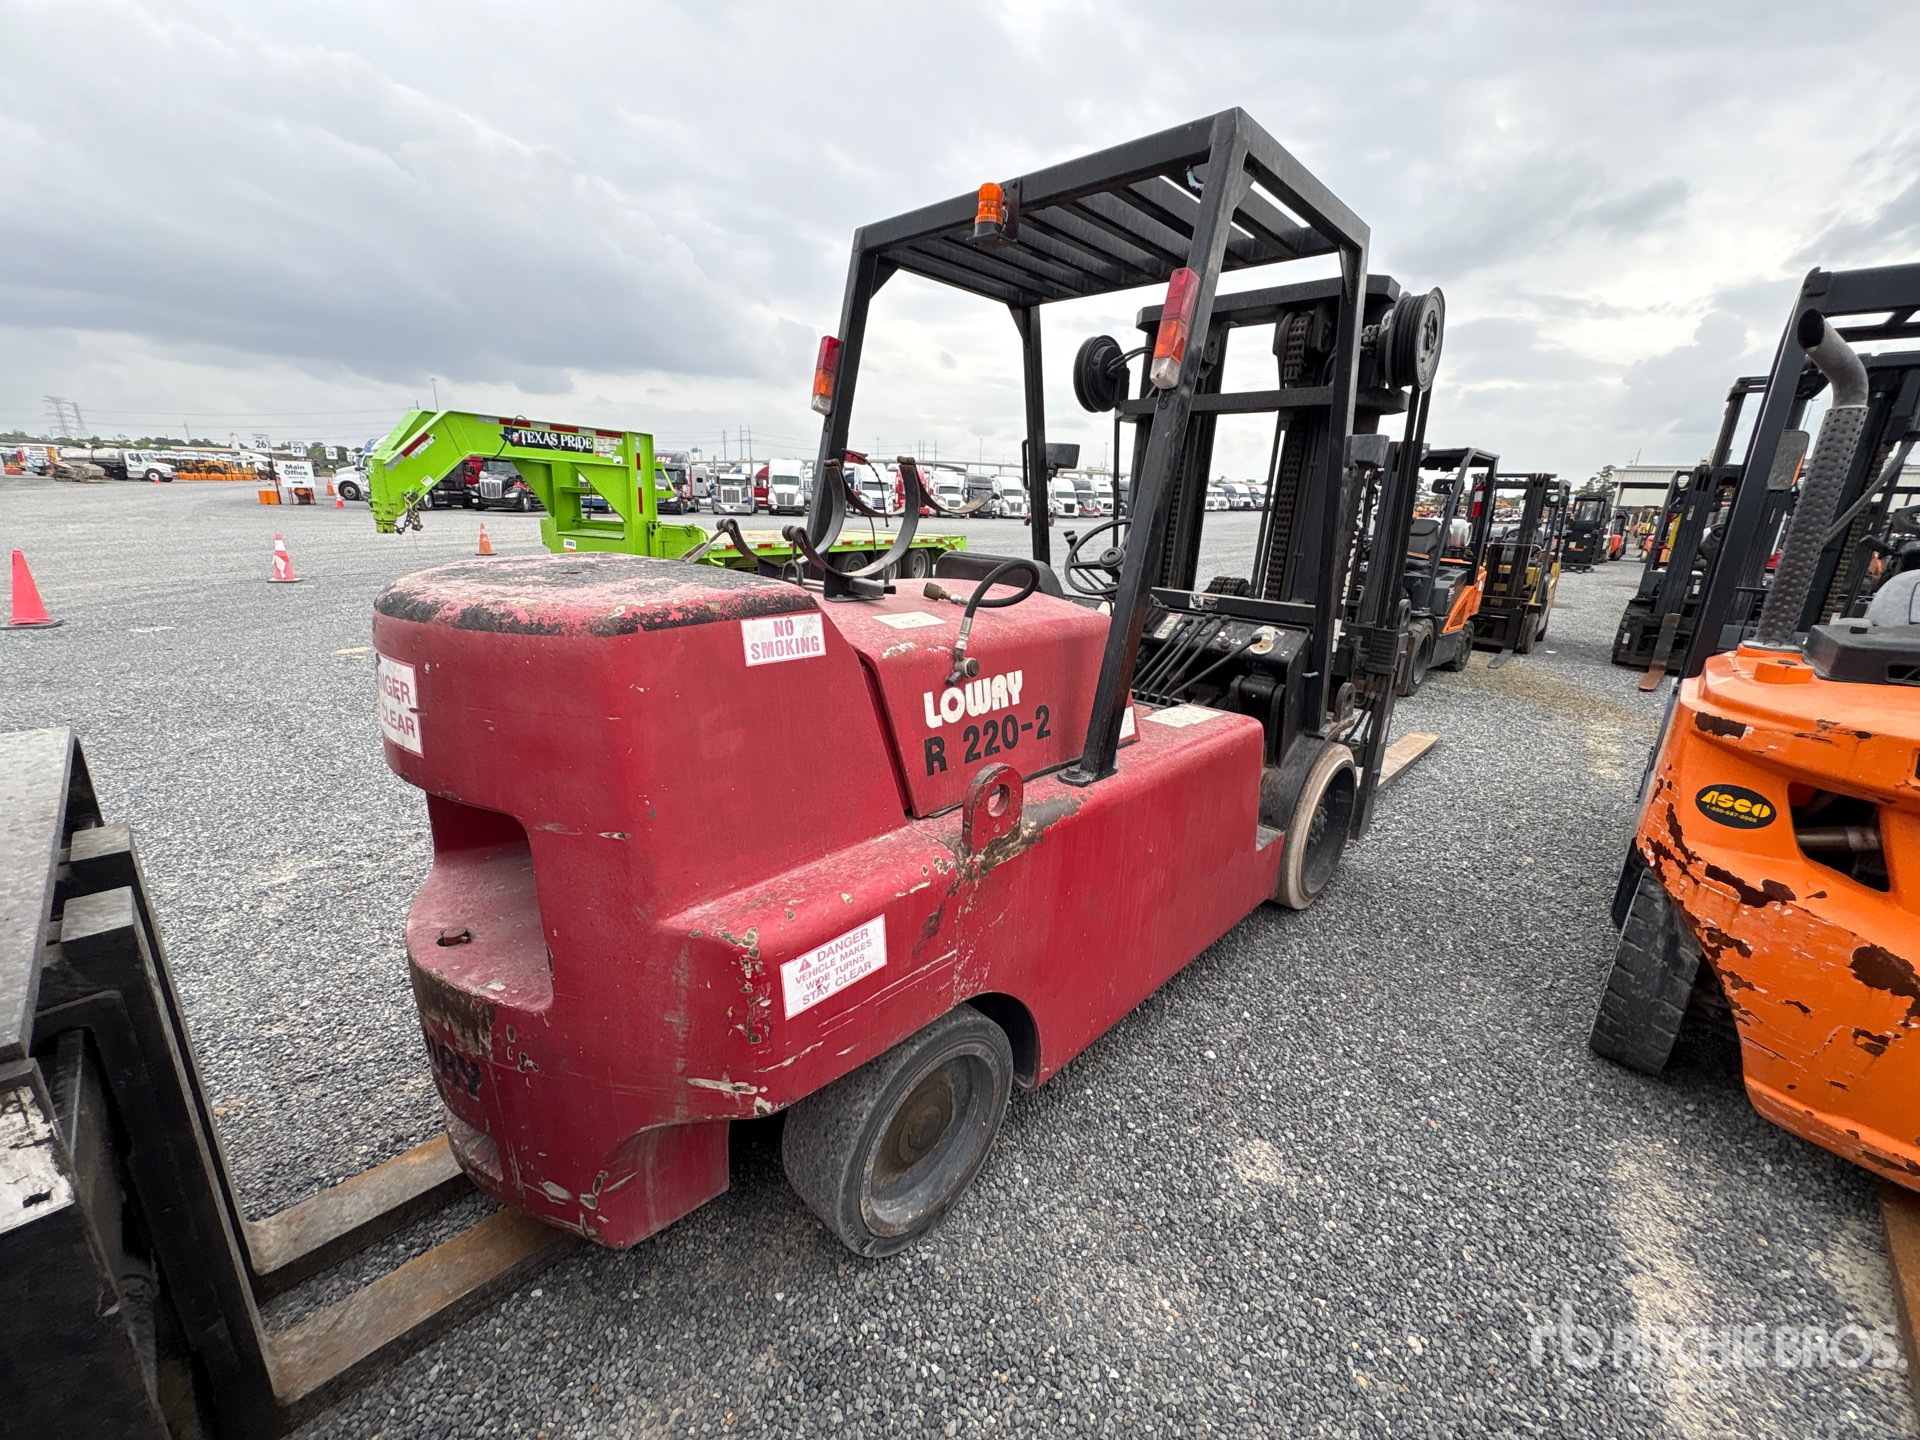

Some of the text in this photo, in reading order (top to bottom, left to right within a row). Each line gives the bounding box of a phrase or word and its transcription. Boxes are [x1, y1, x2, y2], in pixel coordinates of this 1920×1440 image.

[255, 440, 266, 449] 26
[518, 430, 560, 447] TEXAS
[560, 436, 593, 450] PRIDE
[773, 619, 795, 637] NO
[750, 635, 820, 661] SMOKING
[378, 671, 411, 704] NGER
[924, 704, 1051, 777] R 220-2
[1700, 790, 1771, 818] ASCO
[795, 939, 872, 984] VEHICLE MAKES
[817, 928, 869, 962] DANGER
[802, 961, 872, 1005] STAY CLEAR
[805, 954, 865, 991] WIDE TURNS
